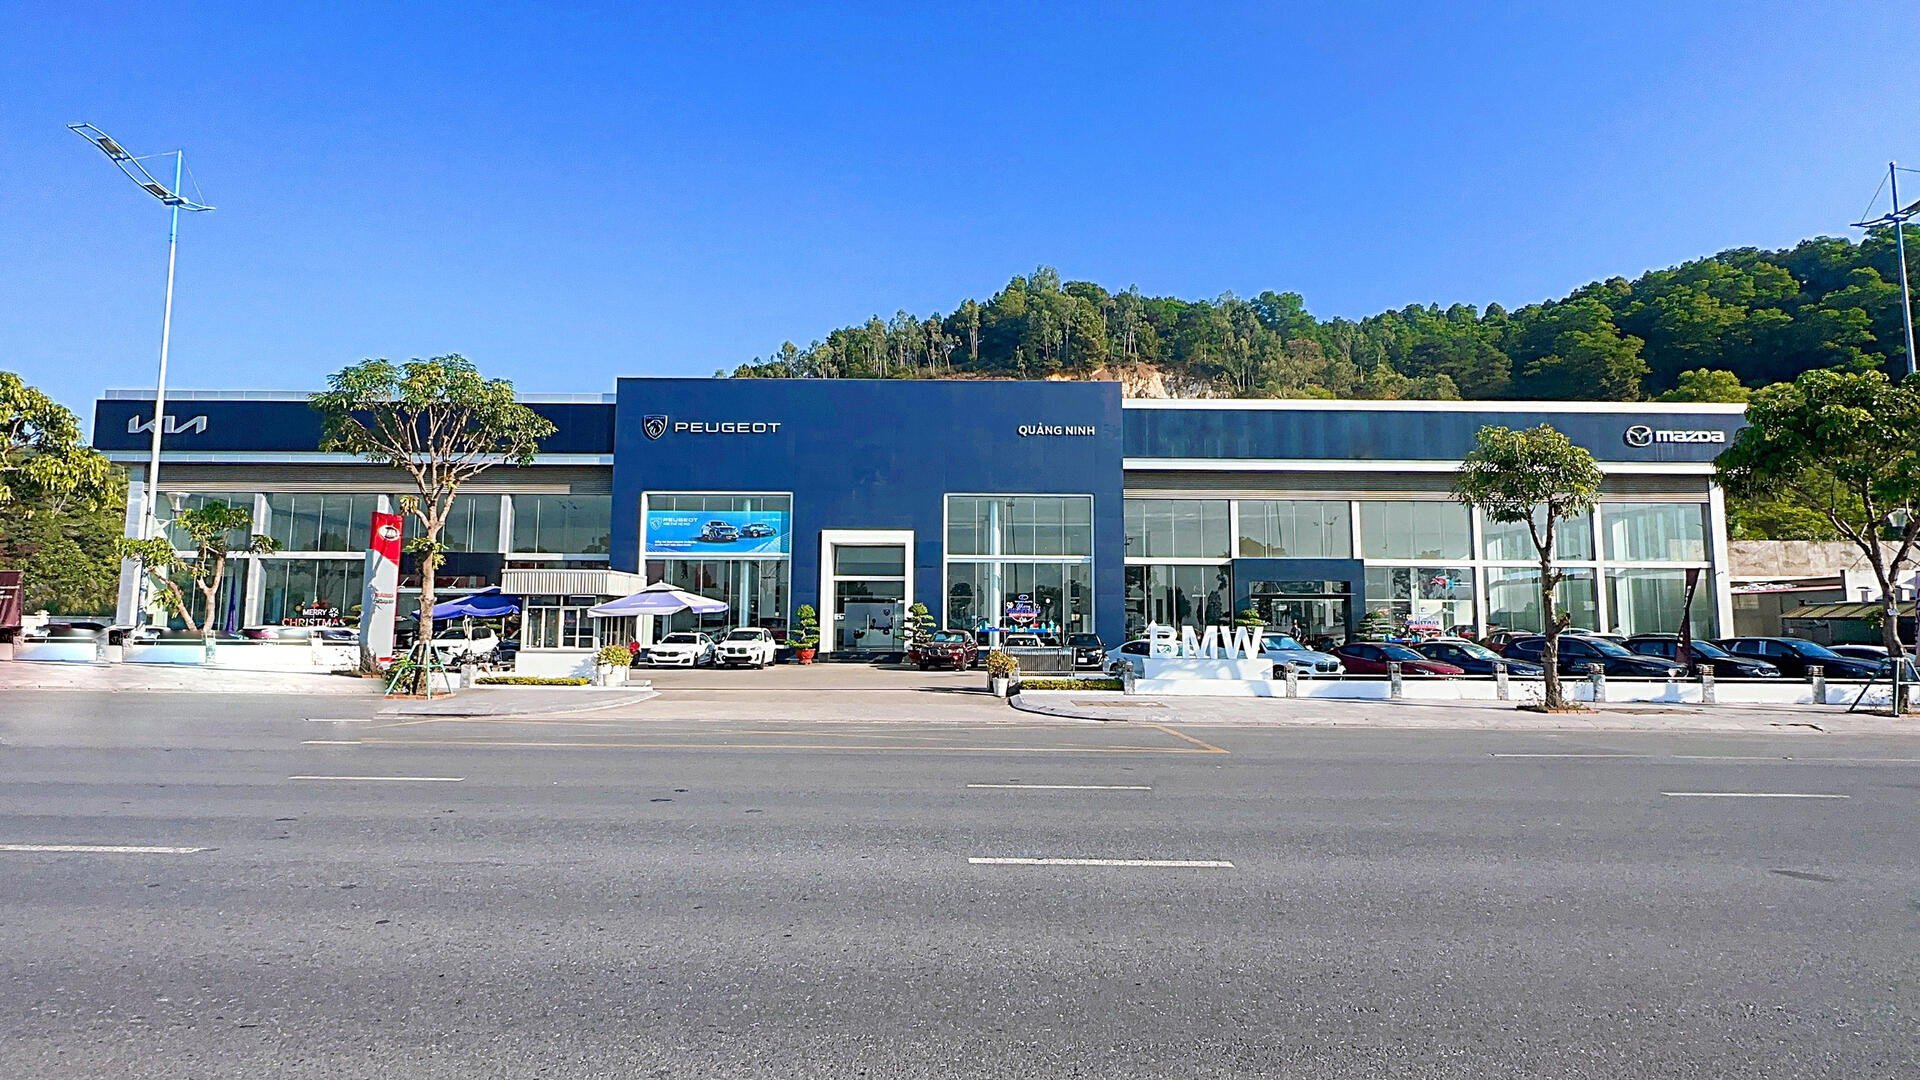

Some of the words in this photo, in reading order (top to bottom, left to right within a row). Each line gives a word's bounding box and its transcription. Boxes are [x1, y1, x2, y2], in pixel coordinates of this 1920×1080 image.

[674, 422, 782, 433] PEUGEOT
[1018, 422, 1062, 437] QUẢNG
[1065, 426, 1095, 436] NINH
[302, 608, 327, 616] MERRY
[282, 617, 346, 627] CHRISTMAS
[1149, 625, 1265, 659] BMW
